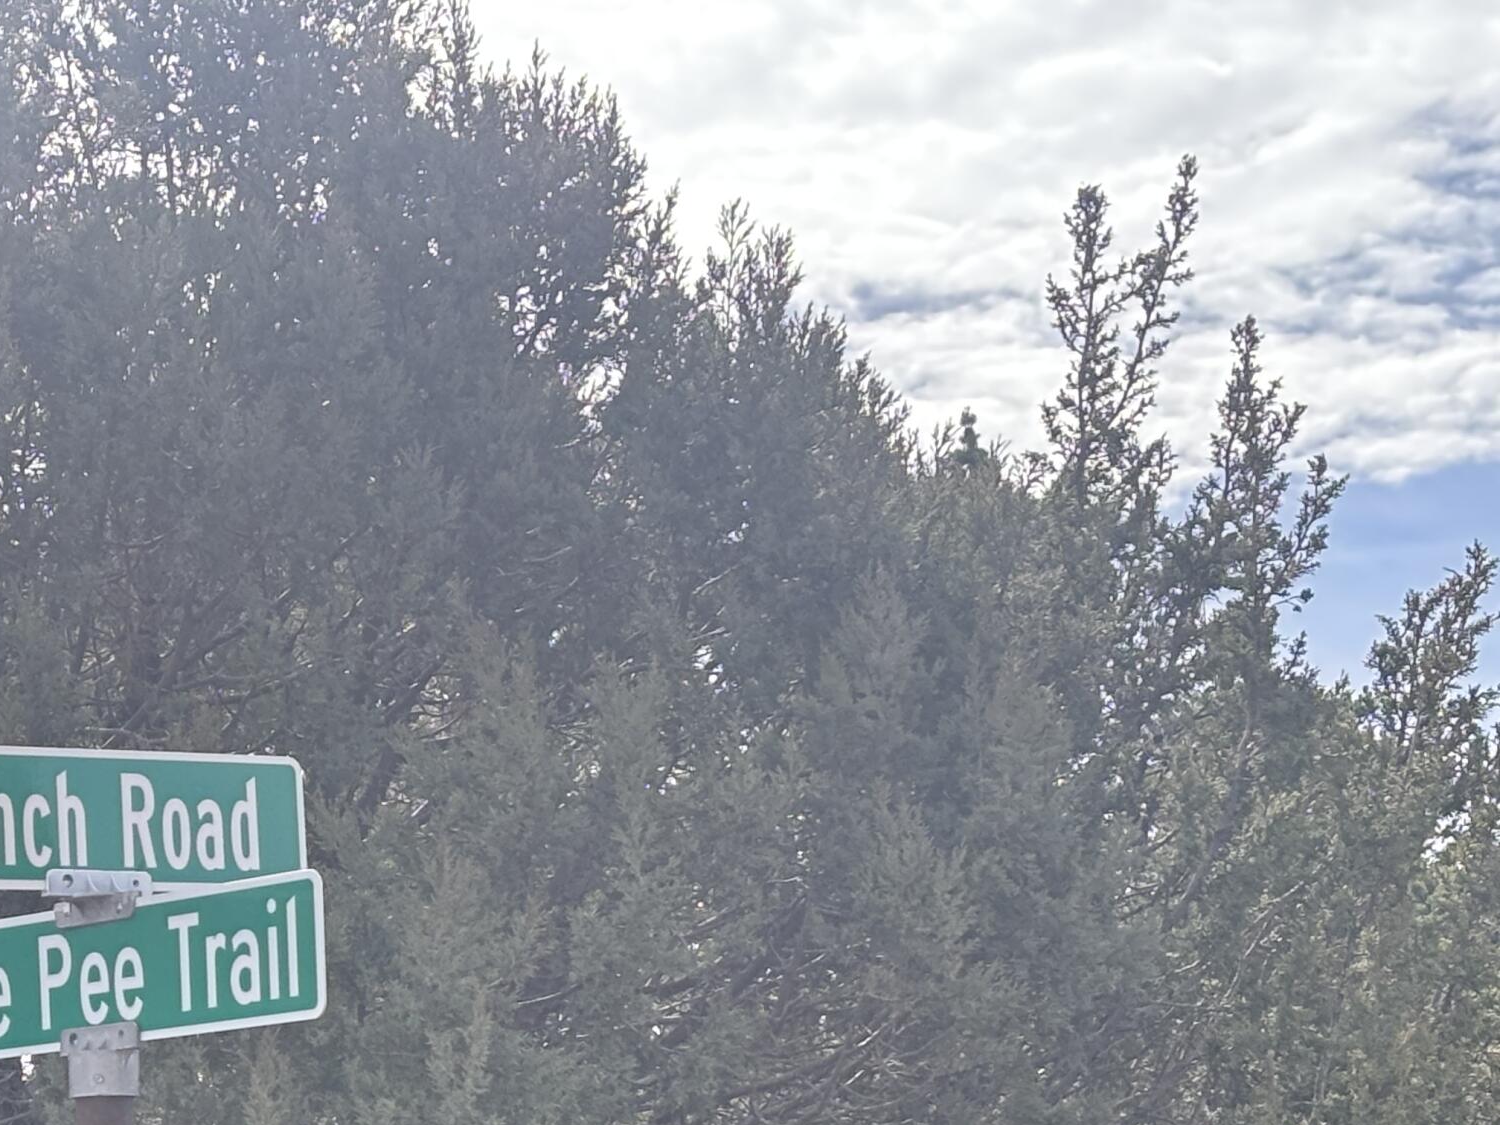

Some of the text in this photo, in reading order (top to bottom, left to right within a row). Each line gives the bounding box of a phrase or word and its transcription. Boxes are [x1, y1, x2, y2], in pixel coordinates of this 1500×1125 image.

[120, 773, 260, 871] Road
[37, 934, 144, 1031] Pee
[167, 896, 300, 1012] Trail
